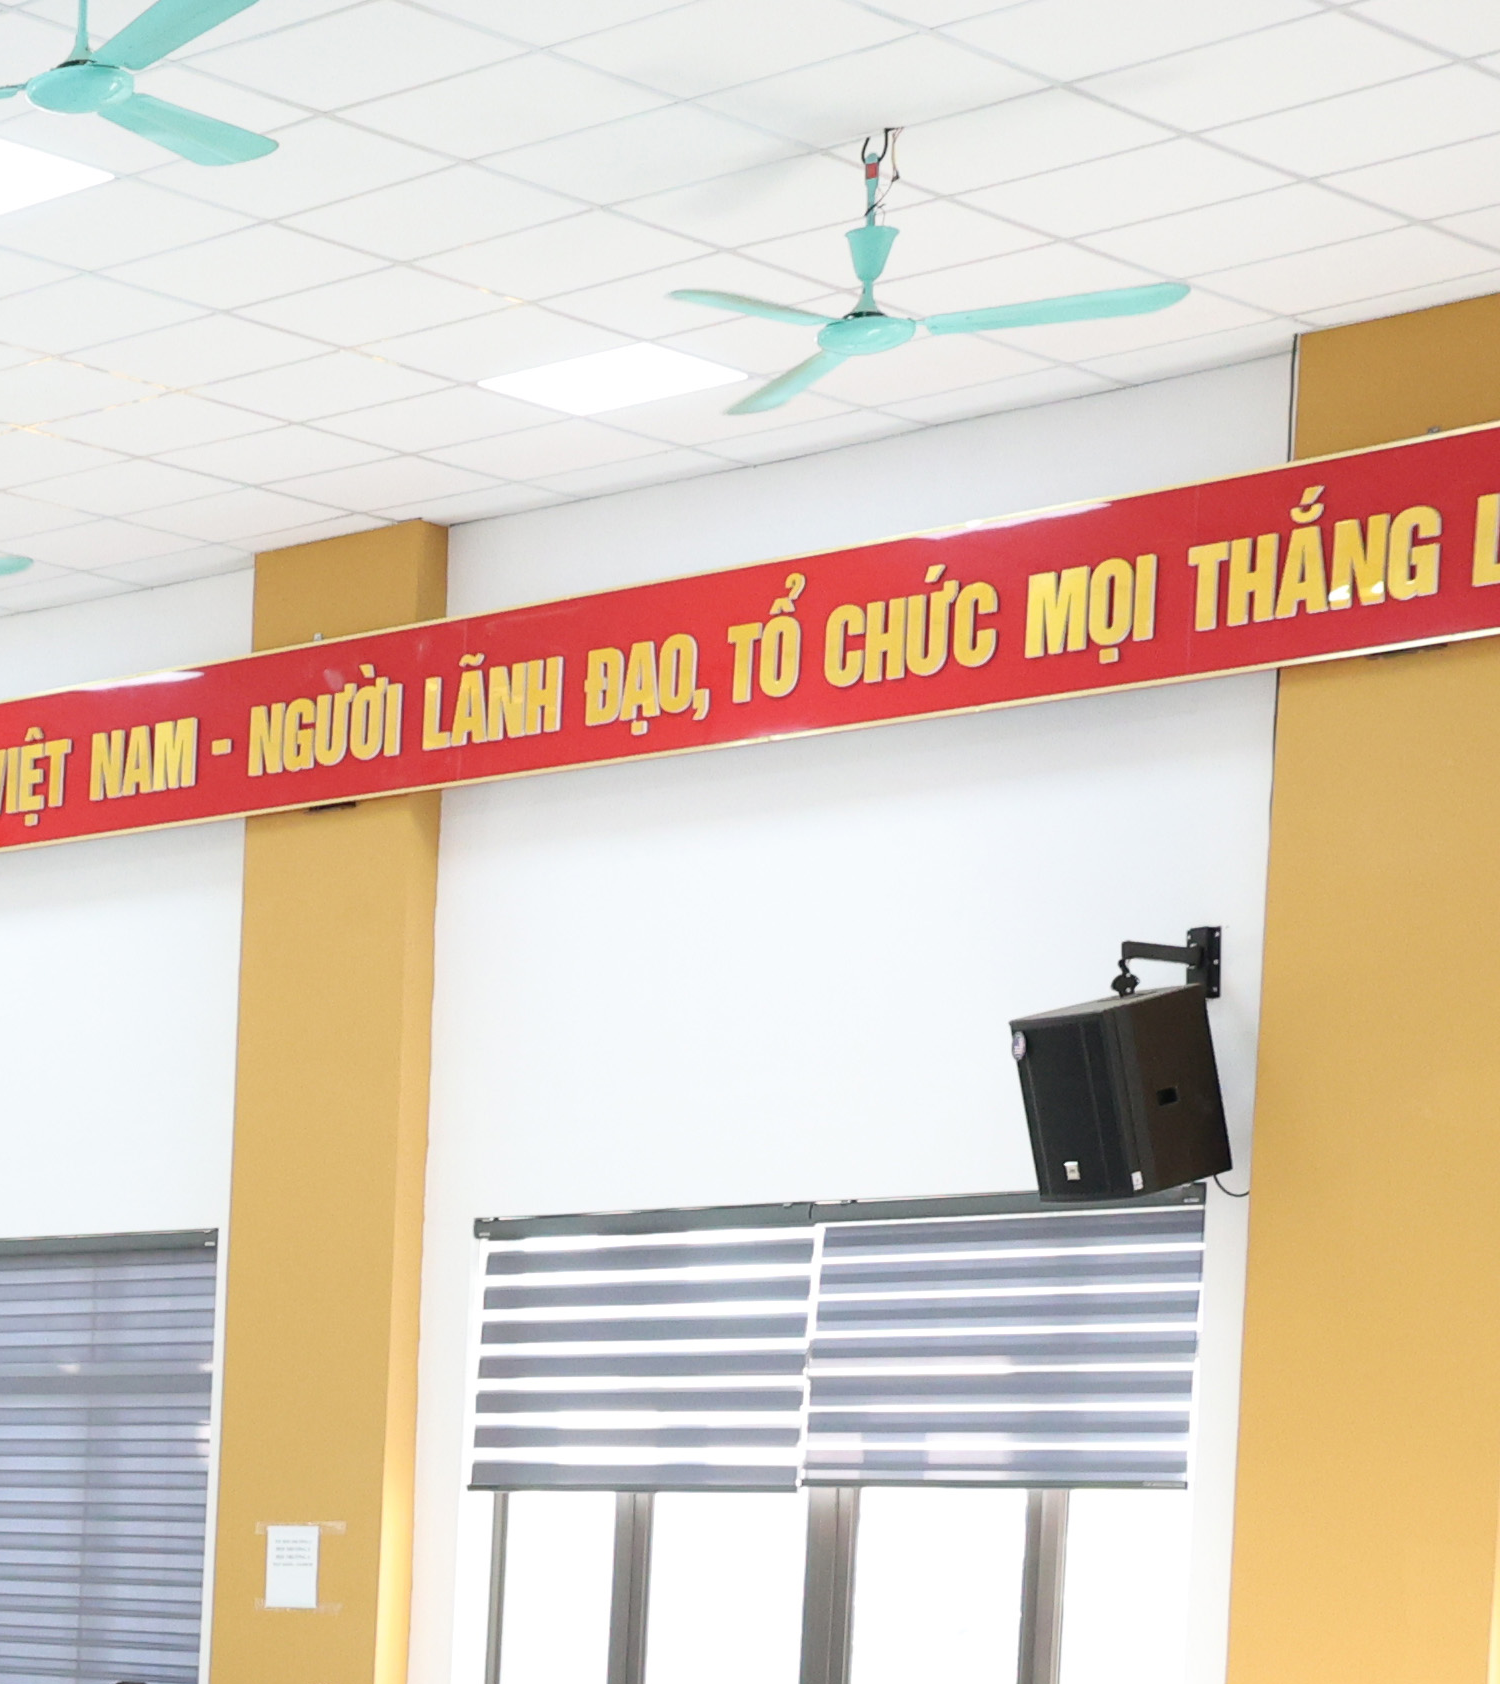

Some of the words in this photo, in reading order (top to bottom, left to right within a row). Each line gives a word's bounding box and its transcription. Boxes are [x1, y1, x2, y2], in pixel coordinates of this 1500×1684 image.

[90, 717, 199, 802] NAM
[247, 664, 402, 777] NGƯỜI
[422, 653, 564, 752] LÃNH
[584, 633, 710, 735] ĐẠO,
[727, 573, 806, 703] TỔ
[823, 564, 998, 688] CHỨC
[1024, 554, 1158, 664] MỌI
[1188, 485, 1442, 632] THẮNG
